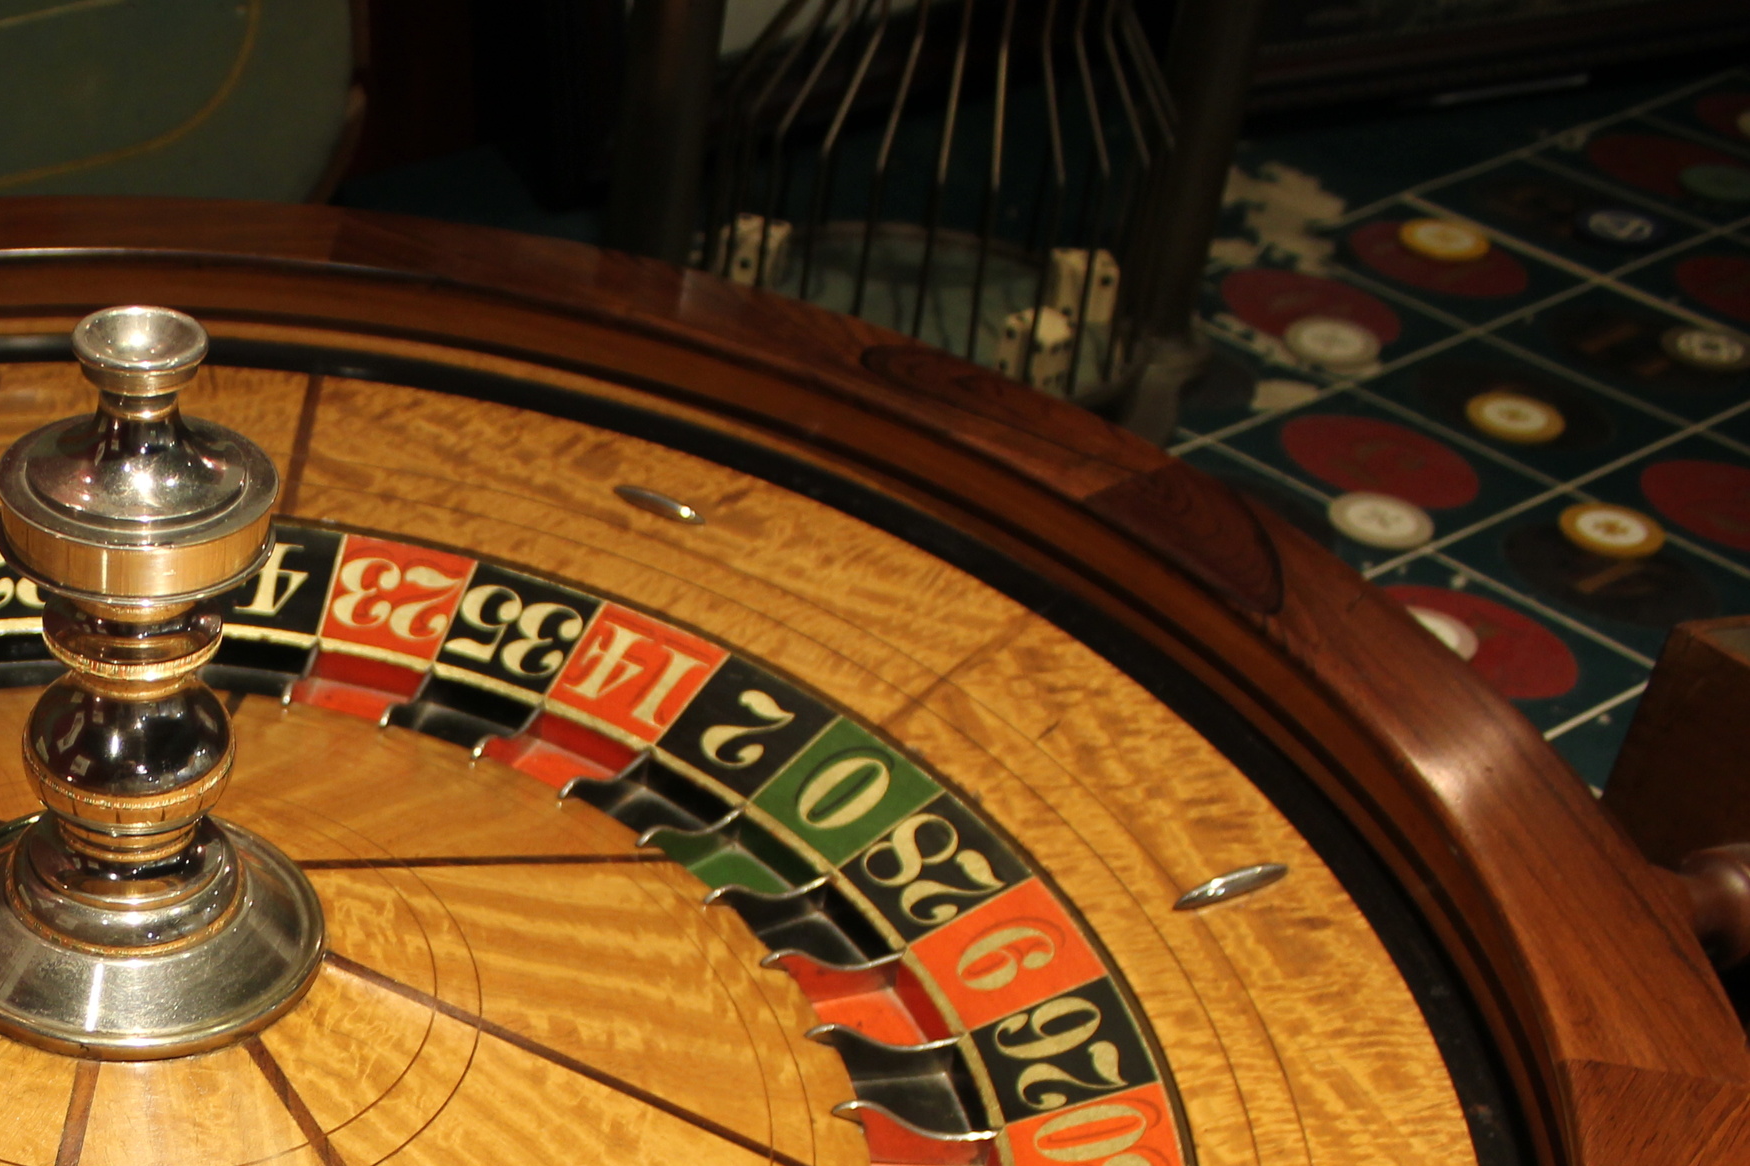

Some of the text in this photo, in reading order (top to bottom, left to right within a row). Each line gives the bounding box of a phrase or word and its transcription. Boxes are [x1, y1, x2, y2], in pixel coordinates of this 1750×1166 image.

[331, 556, 466, 639] 23
[444, 584, 583, 677] 35
[562, 622, 709, 726] 14
[699, 689, 794, 769] 2
[798, 757, 890, 830] 0
[860, 813, 1005, 927] 28
[957, 925, 1055, 991] 9
[994, 997, 1128, 1111] 26
